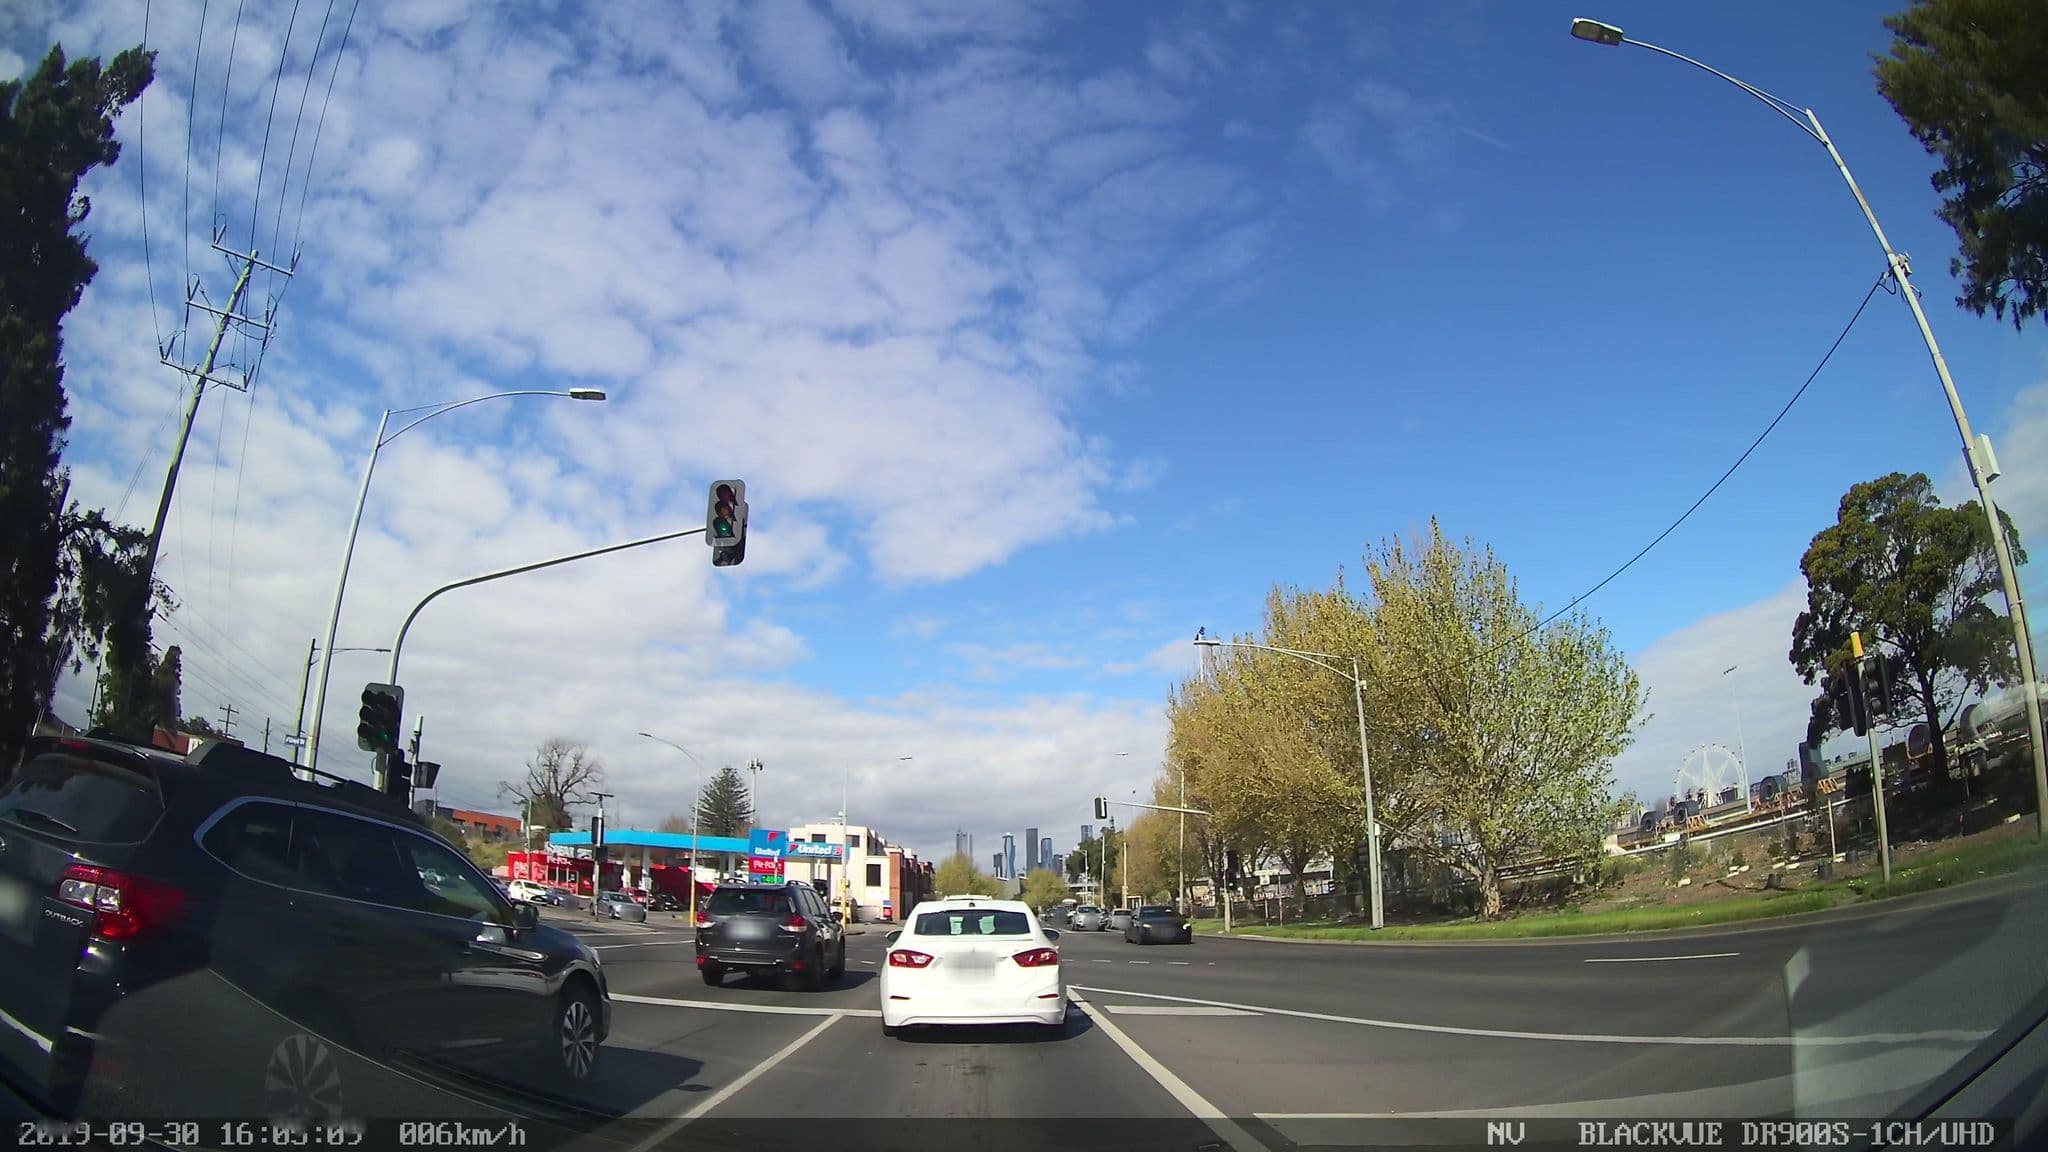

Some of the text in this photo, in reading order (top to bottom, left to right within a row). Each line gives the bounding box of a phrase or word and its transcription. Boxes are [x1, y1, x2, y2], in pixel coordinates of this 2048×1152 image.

[754, 847, 781, 857] United
[798, 844, 832, 854] United
[44, 909, 86, 927] OUTBACK
